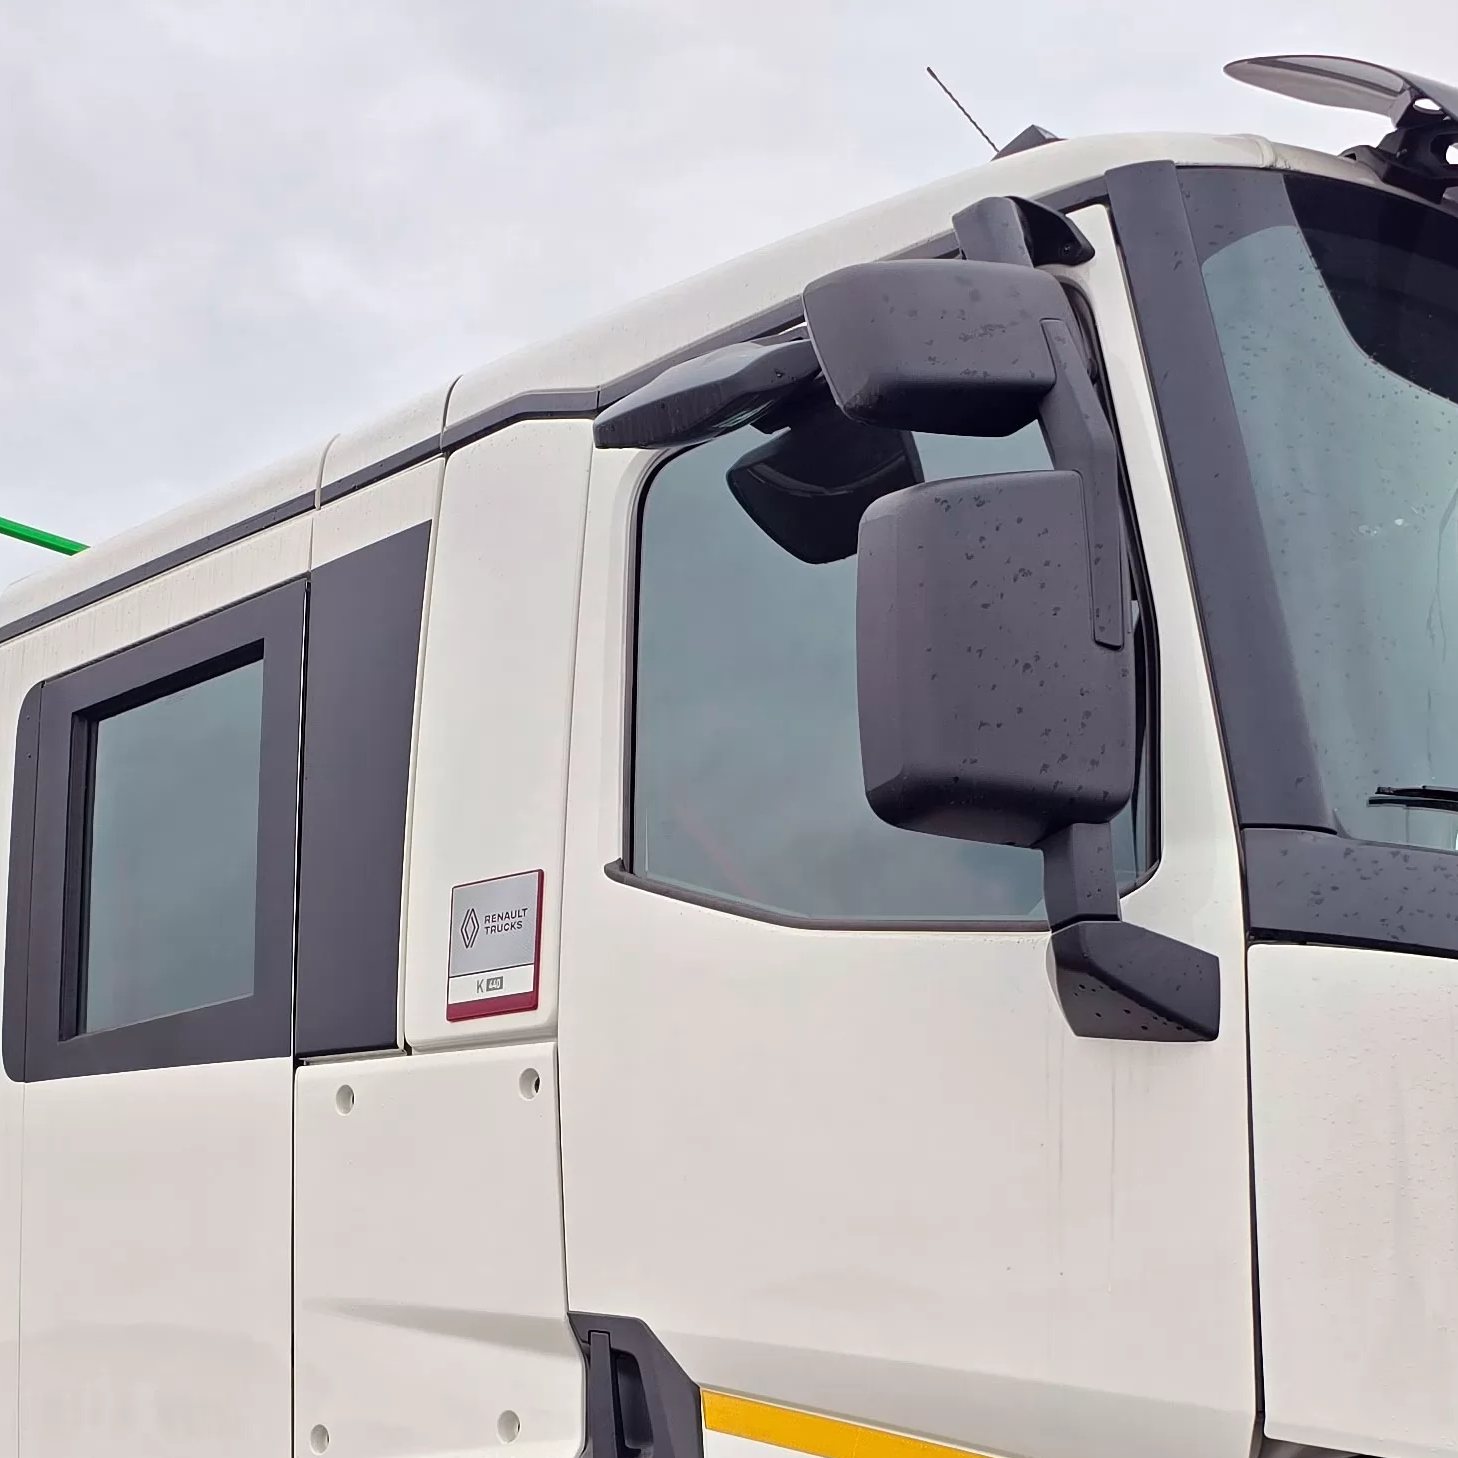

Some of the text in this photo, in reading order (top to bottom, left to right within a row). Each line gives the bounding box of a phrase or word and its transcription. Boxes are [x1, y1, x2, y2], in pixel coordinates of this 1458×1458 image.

[484, 908, 528, 924] RENAULT
[484, 920, 523, 935] TRUCKS
[476, 979, 484, 993] K
